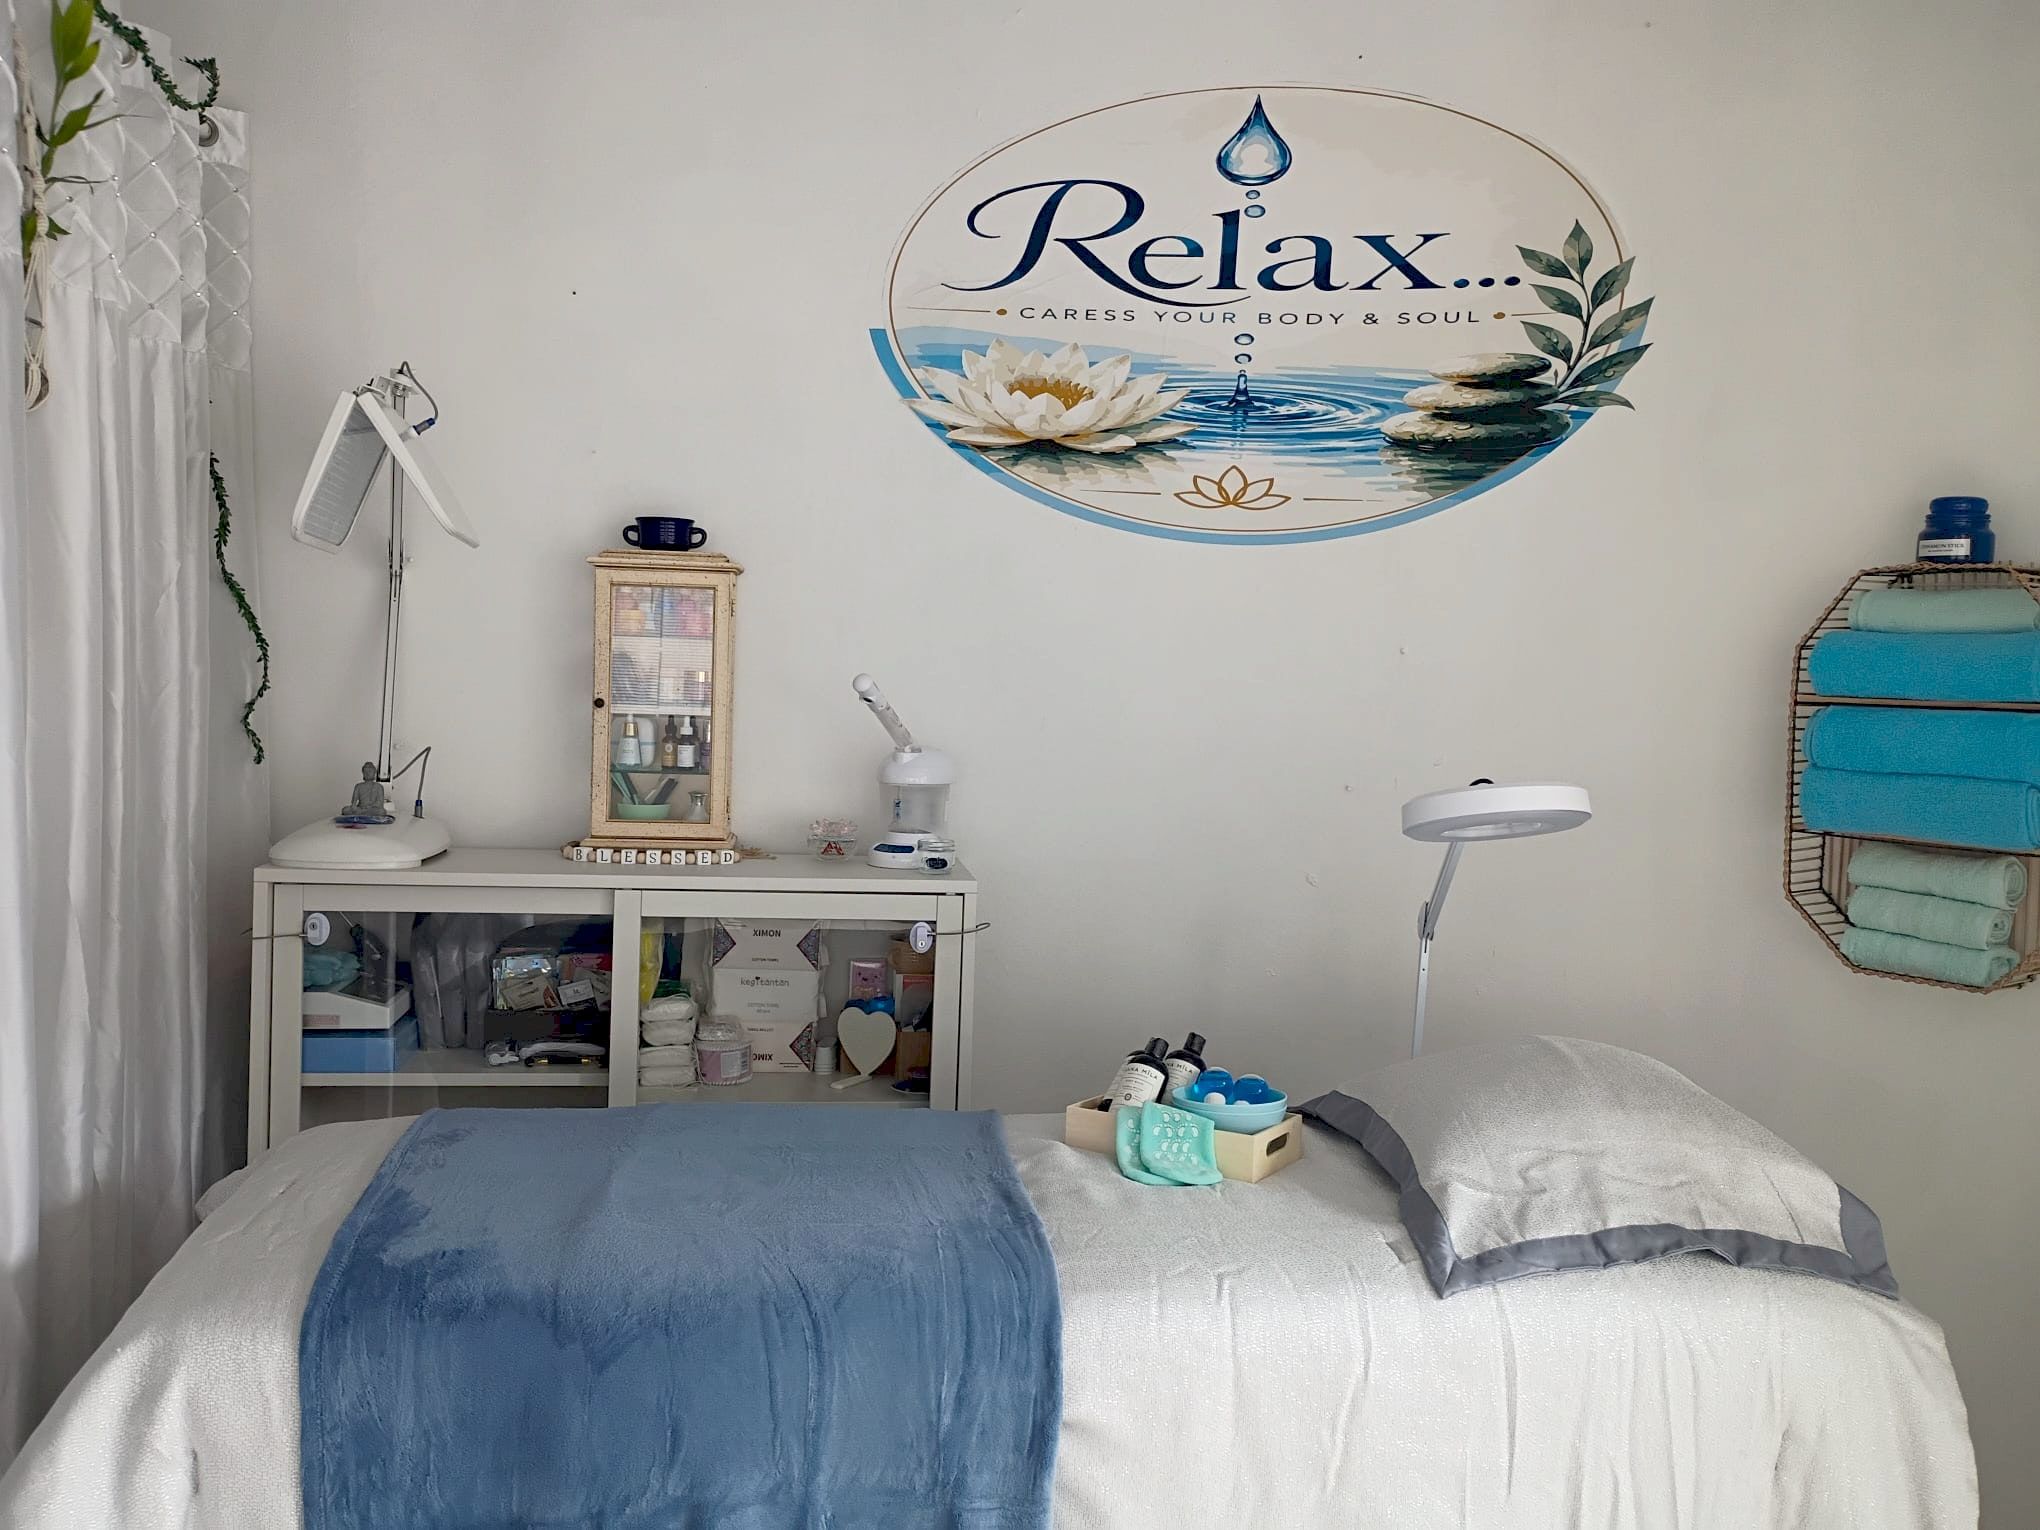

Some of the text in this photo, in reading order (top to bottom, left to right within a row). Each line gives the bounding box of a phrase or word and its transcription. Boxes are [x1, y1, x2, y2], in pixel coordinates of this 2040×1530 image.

[941, 179, 1521, 308] Relax...
[1020, 307, 1480, 325] CARESS YOUR BODY & SOUL
[575, 848, 733, 864] BLESSED
[752, 928, 781, 937] XIMON
